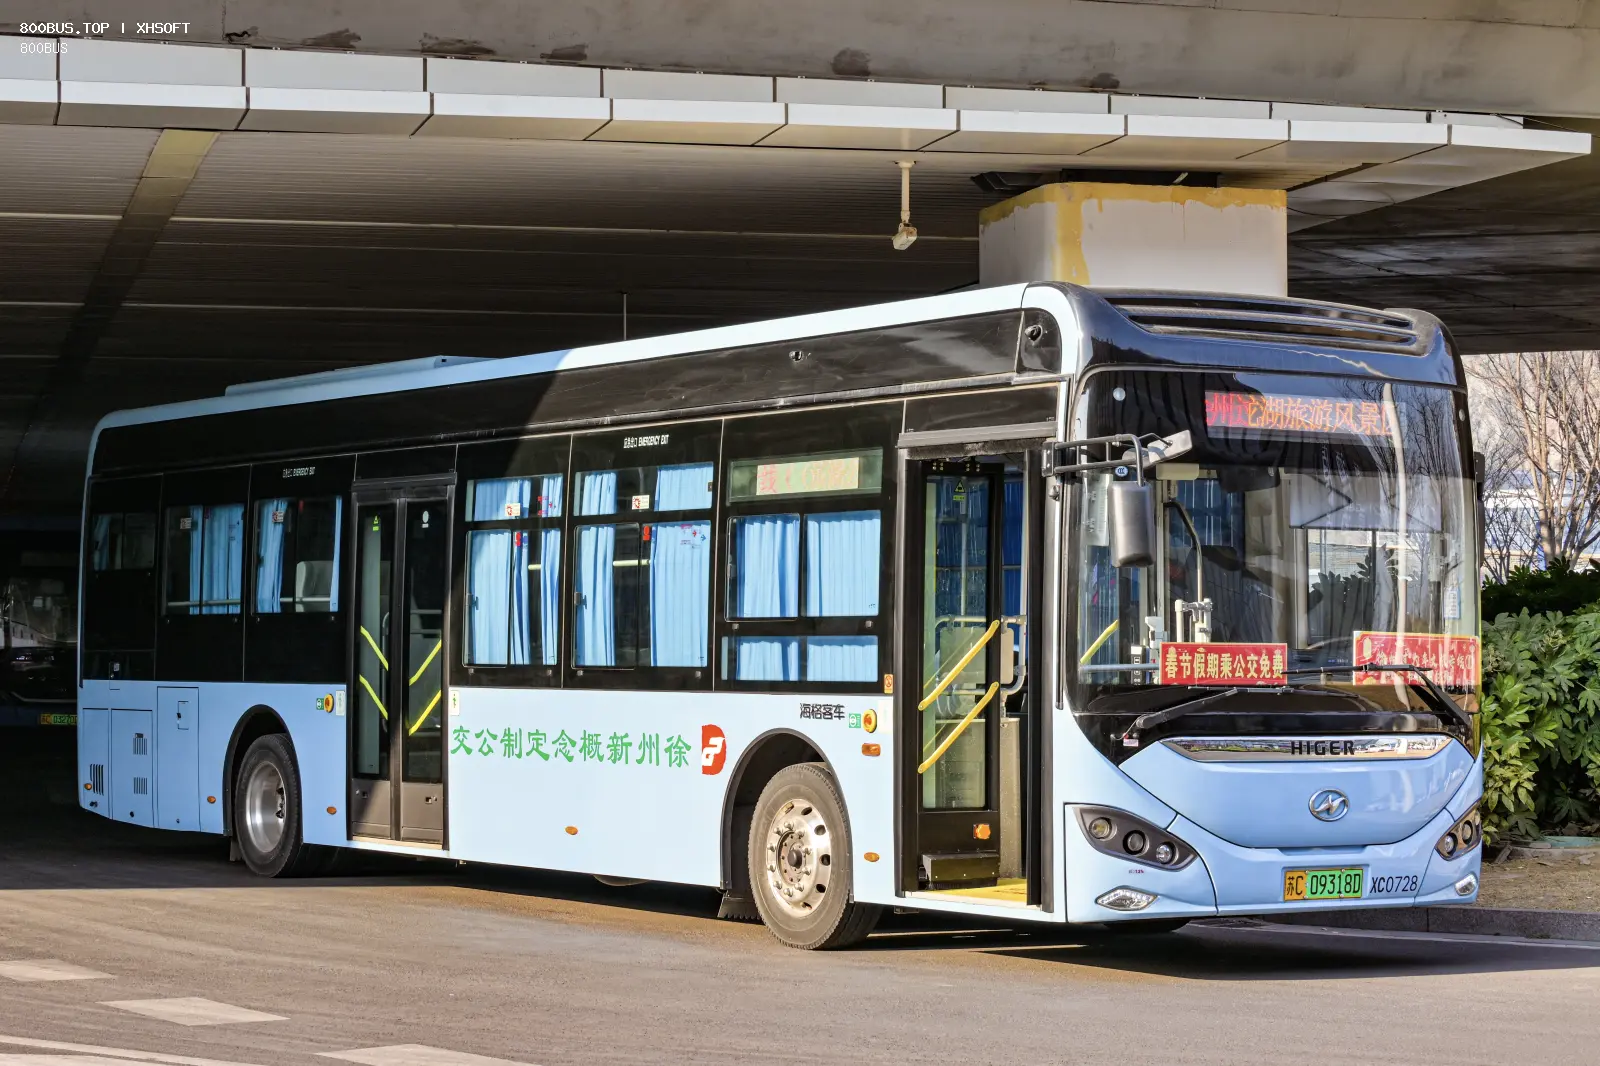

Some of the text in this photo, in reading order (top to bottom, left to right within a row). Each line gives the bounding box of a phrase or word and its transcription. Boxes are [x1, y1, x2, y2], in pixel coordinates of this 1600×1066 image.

[638, 435, 660, 447] EMERGENCY
[660, 434, 669, 445] EXIT
[1165, 652, 1284, 679] 春节假期乘公交免费
[799, 703, 845, 720] 海格客车
[1291, 741, 1354, 755] HIGER
[1310, 873, 1361, 895] 09318D
[1369, 875, 1418, 894] XC0728
